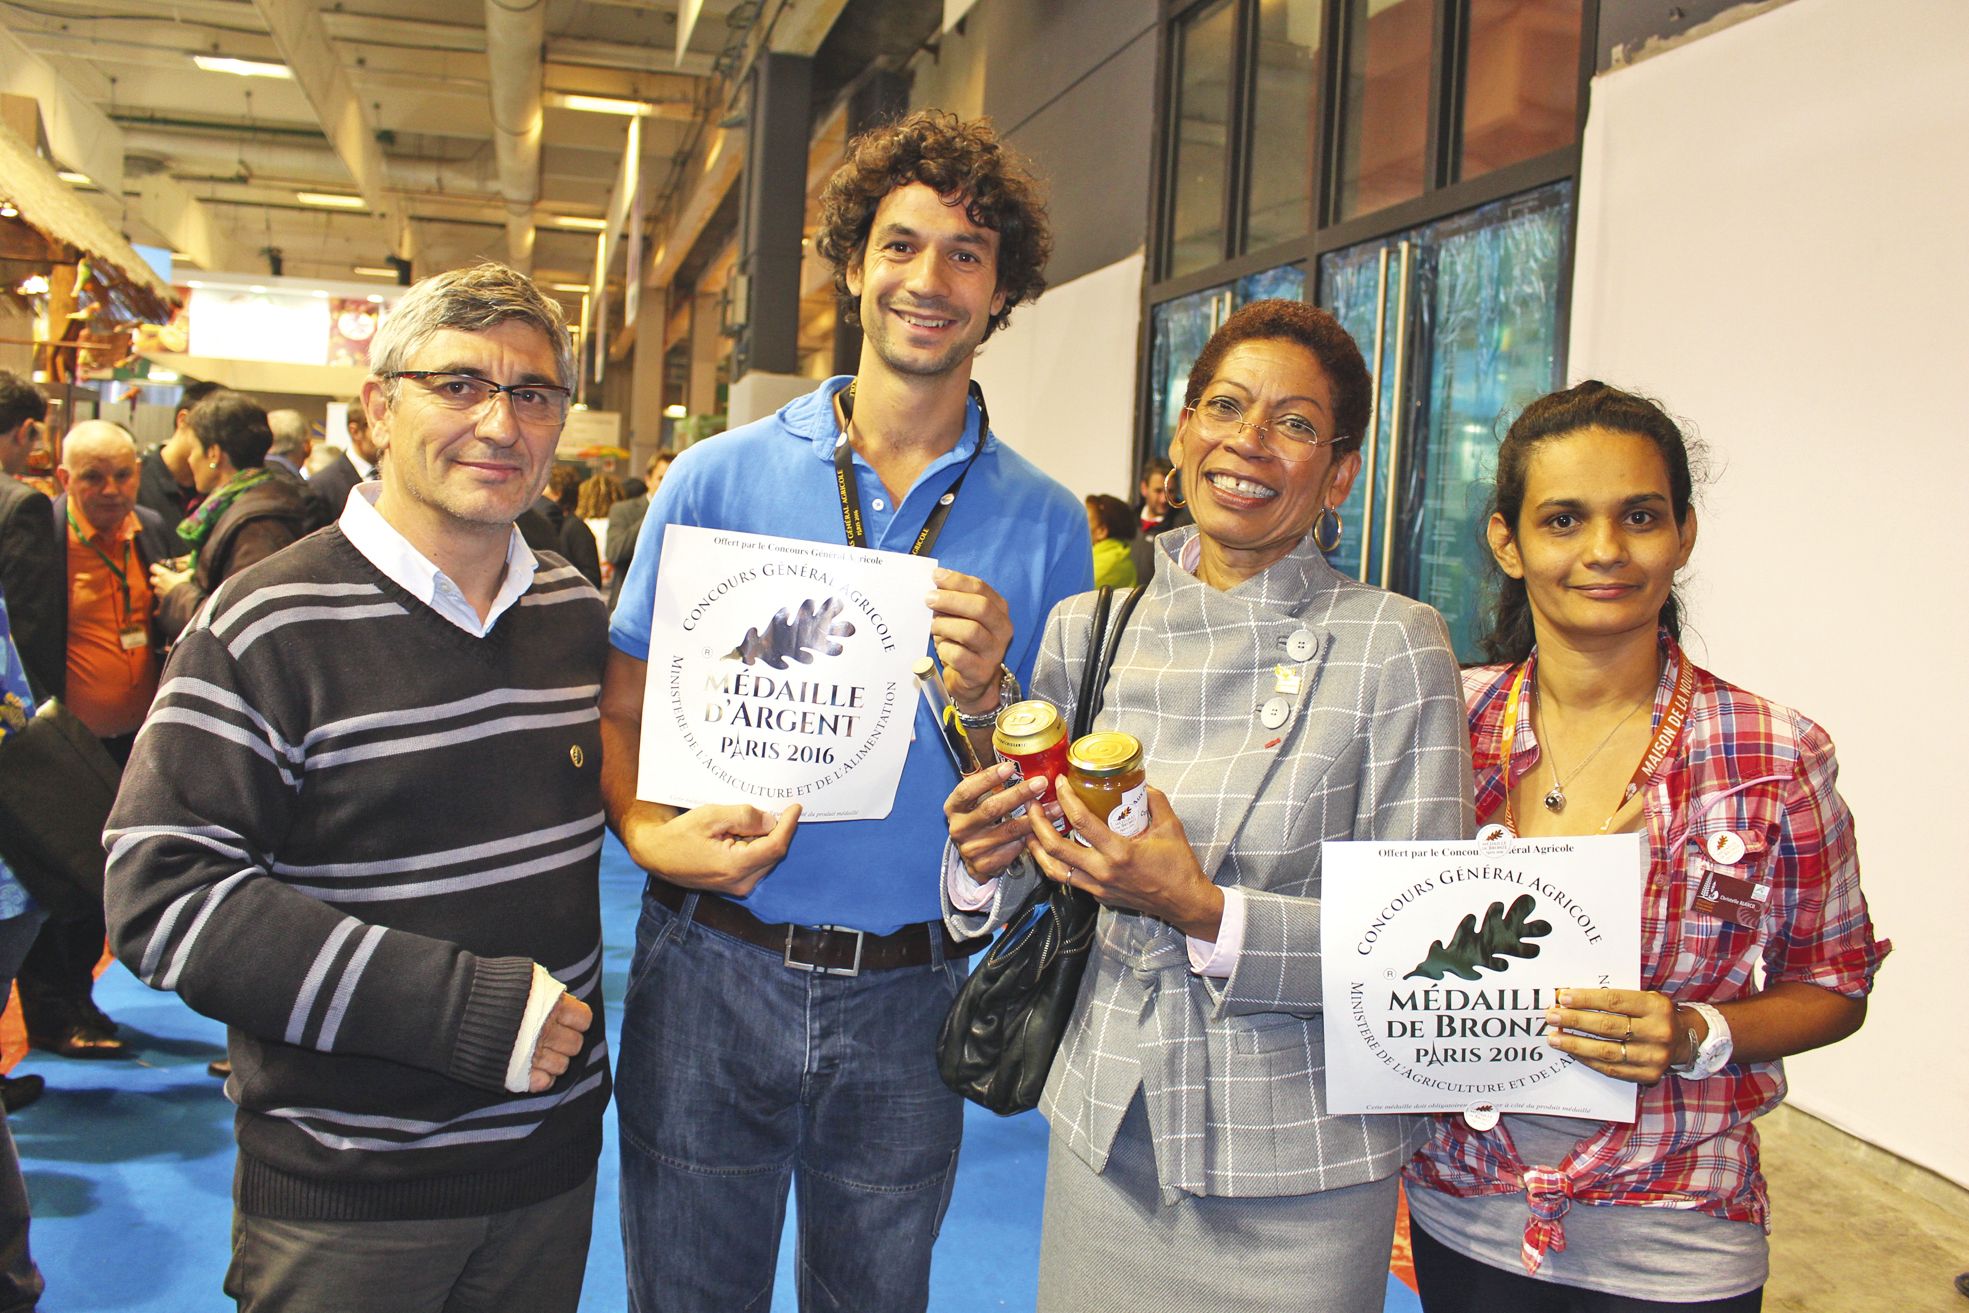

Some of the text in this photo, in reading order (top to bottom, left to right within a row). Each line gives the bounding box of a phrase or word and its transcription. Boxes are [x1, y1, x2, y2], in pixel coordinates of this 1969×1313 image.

[714, 536, 739, 547] Offert
[741, 541, 756, 550] par
[758, 540, 766, 549] le
[768, 543, 809, 556] Concours
[847, 553, 884, 566] Aricole
[911, 528, 930, 555] GRICOLE
[683, 562, 896, 654] CONCOURS GÉNÉRAL AGRICOLE
[705, 668, 865, 709] MÉDAILLE
[1675, 694, 1689, 712] LA
[704, 699, 861, 738] D'ARGENT
[1667, 708, 1685, 728] DE
[683, 732, 699, 751] DE
[797, 783, 813, 796] ET
[815, 775, 834, 791] DE
[721, 729, 835, 765] PARIS 2016
[1641, 725, 1677, 777] MAISON
[1378, 848, 1409, 857] Offert
[1411, 849, 1427, 859] par
[1429, 848, 1439, 857] le
[1441, 848, 1481, 857] Concou
[1534, 844, 1575, 855] Agricole
[1357, 864, 1603, 956] CONCOURS GÉNÉRAL AGRICOLE
[1350, 981, 1549, 1094] MINISTERE DE L'AGRICULTURE ET DE
[1387, 1014, 1550, 1039] DE BRONZ
[1415, 1040, 1543, 1068] PARIS 2016
